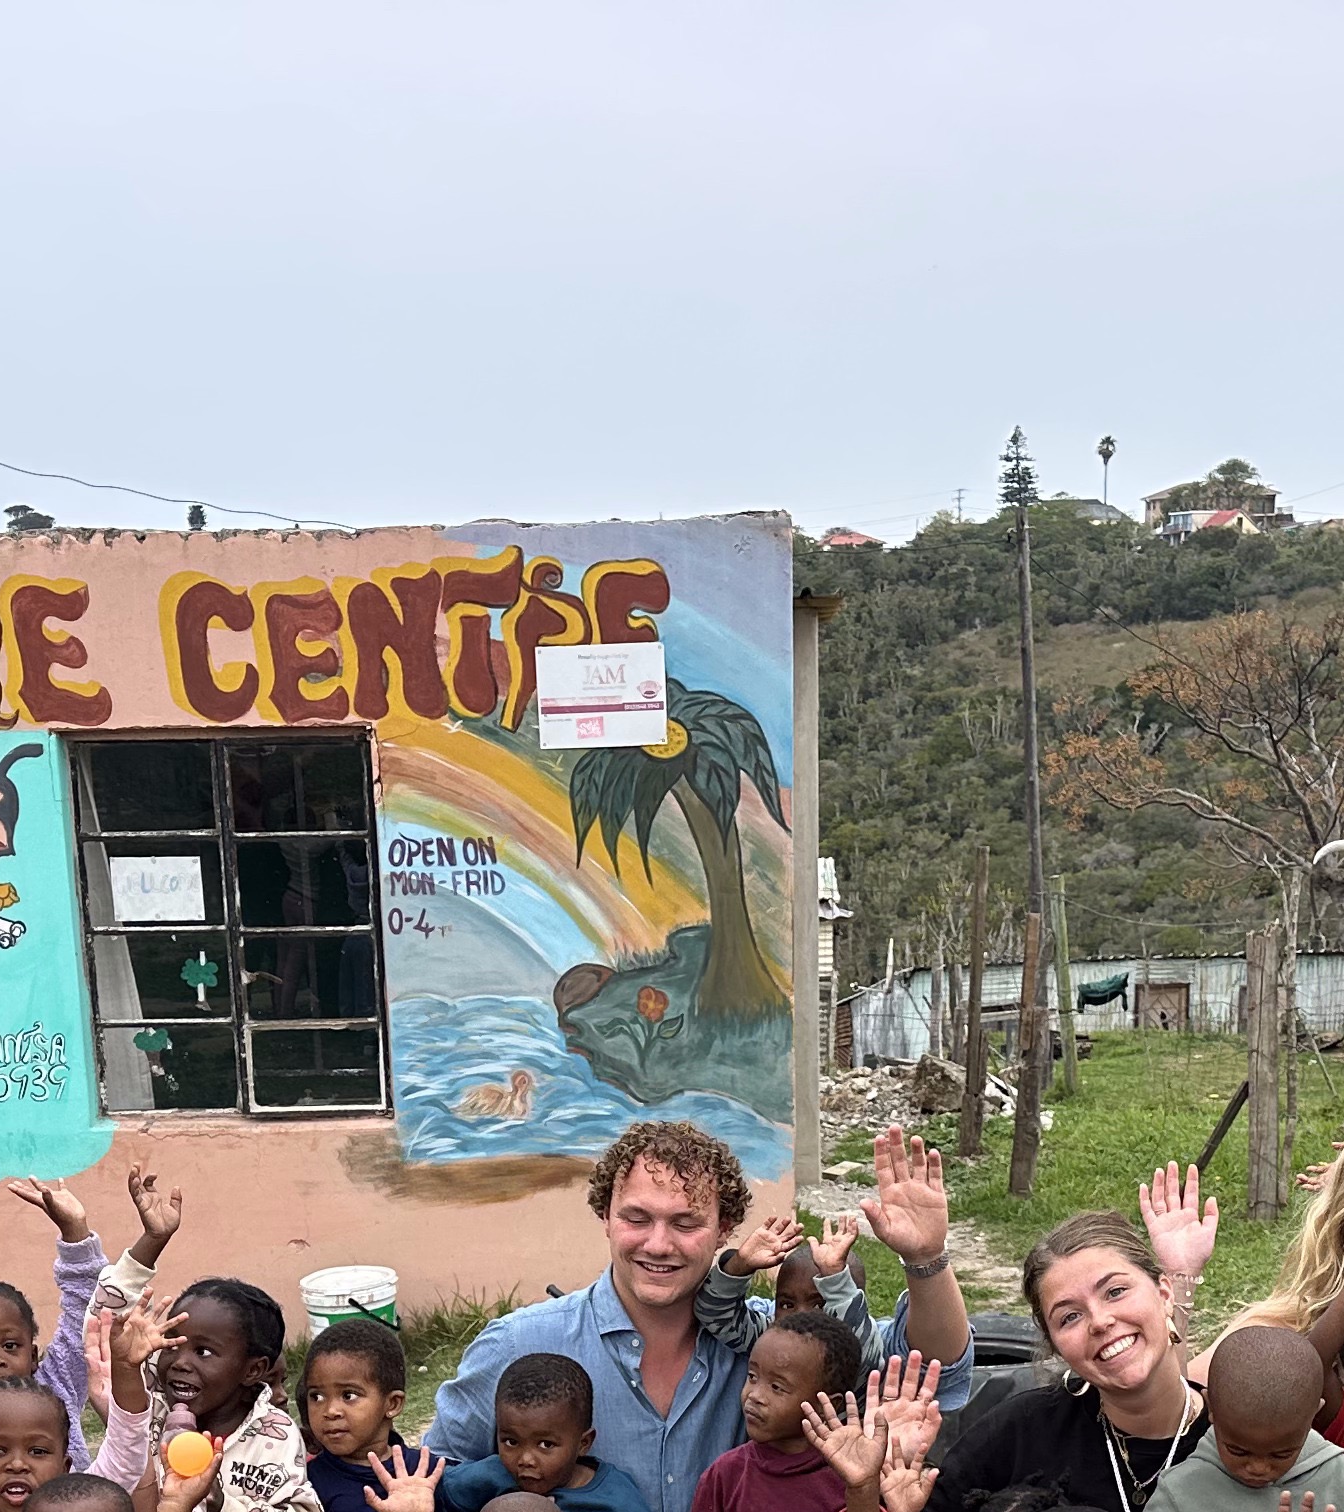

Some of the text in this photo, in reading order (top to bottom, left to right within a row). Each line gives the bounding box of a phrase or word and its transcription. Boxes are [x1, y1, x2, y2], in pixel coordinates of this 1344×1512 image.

[582, 663, 627, 685] JAM
[388, 831, 497, 867] OPEN ON
